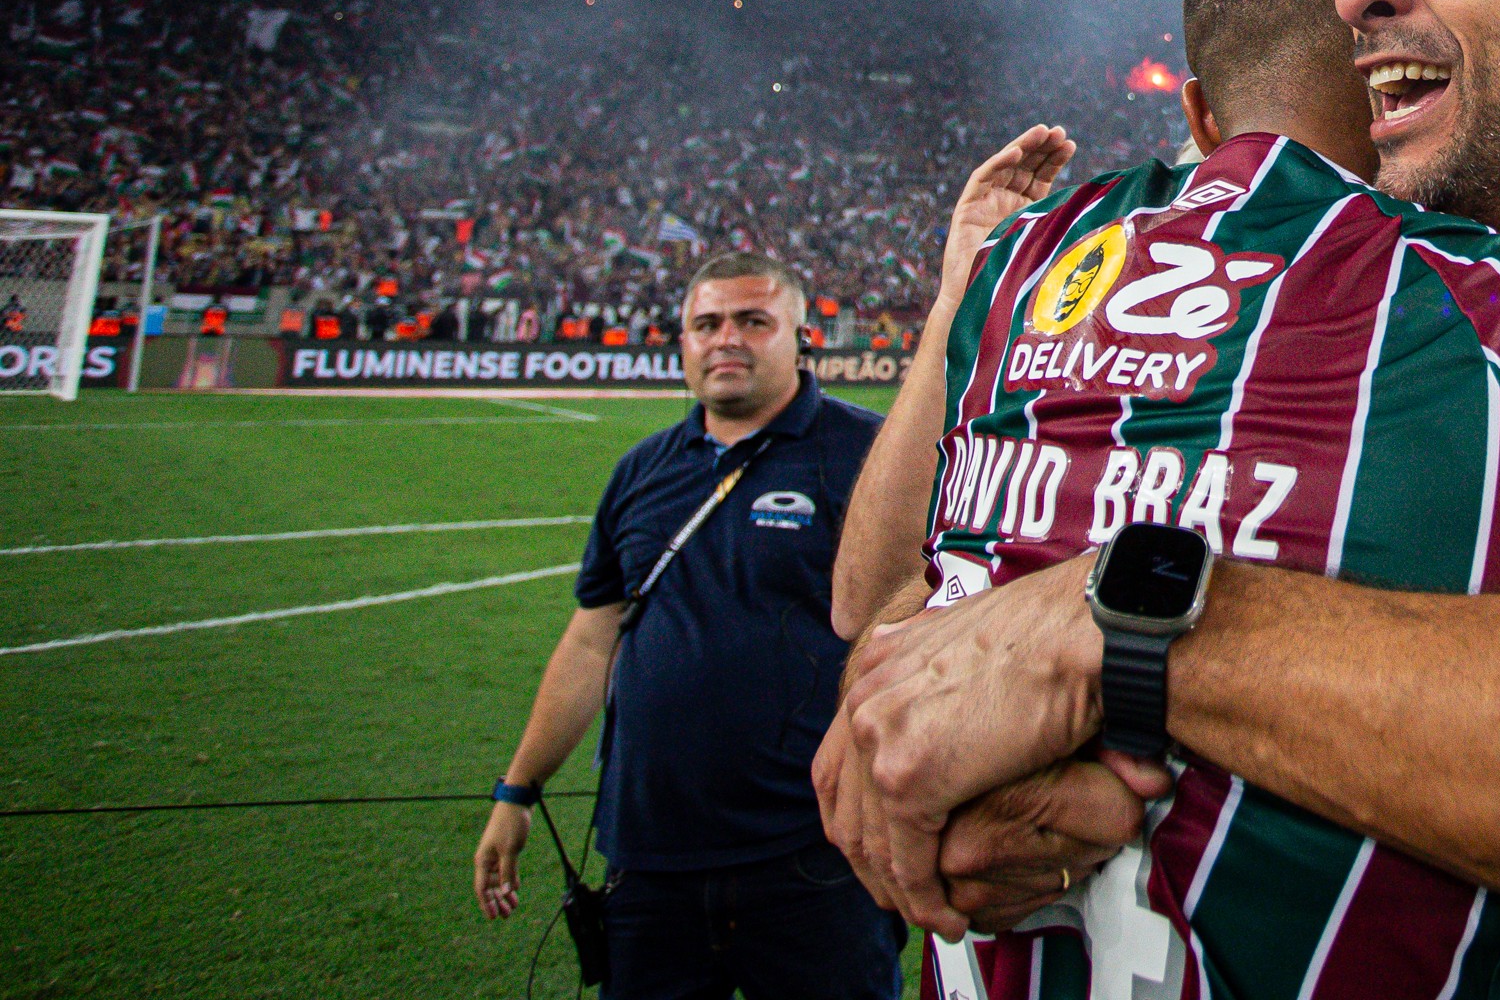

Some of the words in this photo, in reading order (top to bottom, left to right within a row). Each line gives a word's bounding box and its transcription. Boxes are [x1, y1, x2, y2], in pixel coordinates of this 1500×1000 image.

[1105, 241, 1275, 339] Zé
[0, 344, 117, 378] ORS
[291, 348, 519, 379] FLUMINENSE
[524, 349, 685, 379] FOOTBALL
[1008, 336, 1207, 391] DELIVERY
[943, 435, 1068, 540] DAVID
[1088, 449, 1298, 560] BRAZ
